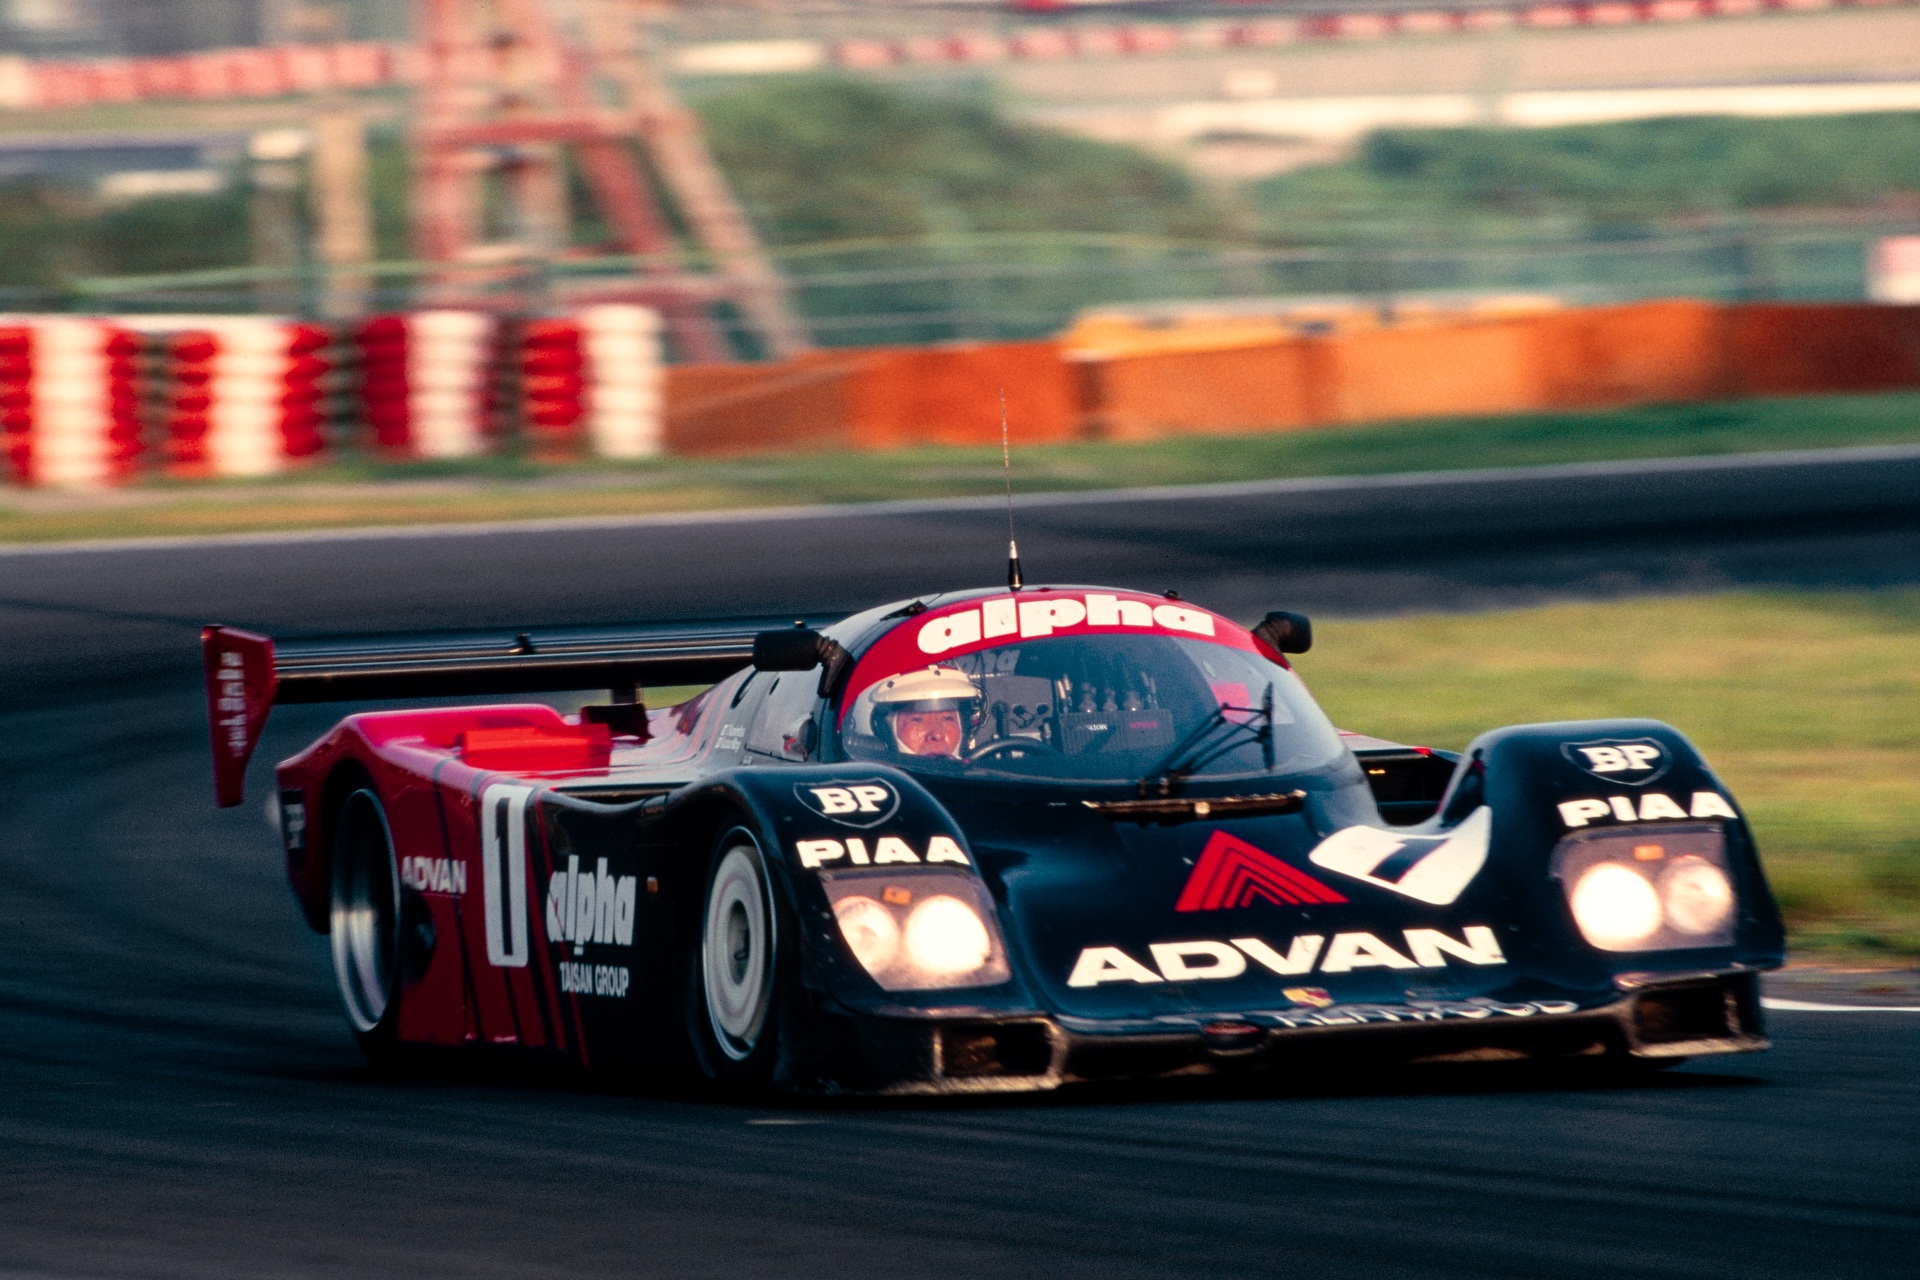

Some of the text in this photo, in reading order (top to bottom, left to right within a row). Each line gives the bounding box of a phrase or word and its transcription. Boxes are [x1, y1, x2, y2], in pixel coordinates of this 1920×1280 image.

[917, 594, 1215, 654] alpha
[1577, 743, 1662, 772] BP
[809, 785, 889, 814] BP
[1557, 792, 1737, 827] PIAA
[796, 836, 971, 868] PIAA
[402, 856, 467, 895] ADVAN
[495, 797, 513, 956] 1
[546, 854, 637, 956] alpha
[1066, 926, 1507, 988] ADVAN
[560, 962, 630, 998] TAISAN GROUP
